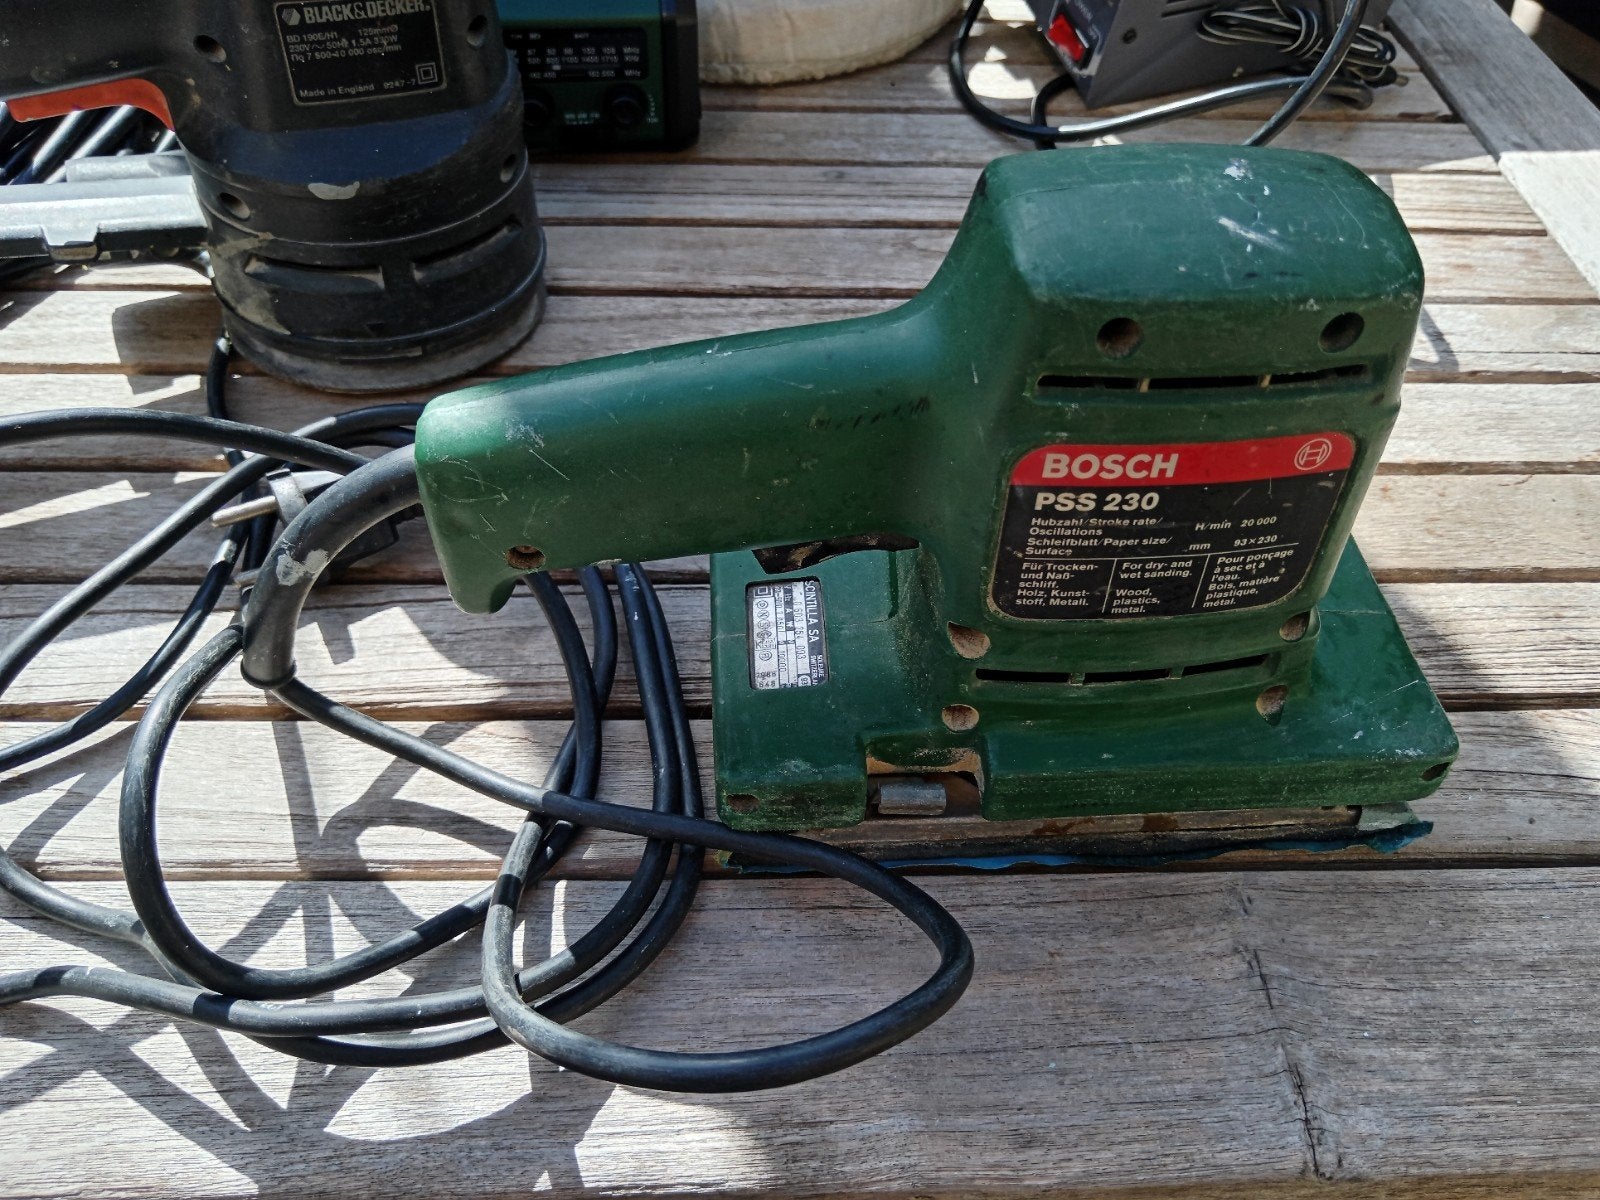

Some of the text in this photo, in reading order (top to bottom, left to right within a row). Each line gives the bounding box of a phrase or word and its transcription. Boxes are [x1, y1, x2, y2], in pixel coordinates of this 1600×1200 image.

[300, 89, 325, 98] Made
[338, 84, 375, 94] England
[1042, 453, 1179, 479] BOSCH
[1034, 491, 1160, 512] PSS 230
[1133, 517, 1164, 526] rate/
[1194, 516, 1277, 531] H/min 20 000
[1029, 527, 1103, 536] Oscillations
[1142, 536, 1173, 546] size/
[1025, 547, 1073, 556] Surface
[1188, 543, 1211, 551] mm
[1217, 549, 1294, 565] Pour ponçage
[1022, 562, 1098, 571] Für Trocken-
[1122, 560, 1193, 570] For dry- and
[1046, 572, 1075, 580] Naß-
[1120, 569, 1193, 579] wet sanding.
[1211, 574, 1240, 582] l'eau.
[1239, 575, 1281, 587] matière
[1017, 589, 1090, 598] Holz, Kunst-
[1016, 598, 1089, 606] stoff, Metall.
[1203, 599, 1236, 608] métal.
[805, 581, 819, 642] SCINTILLA SA
[1111, 606, 1146, 614] metal.
